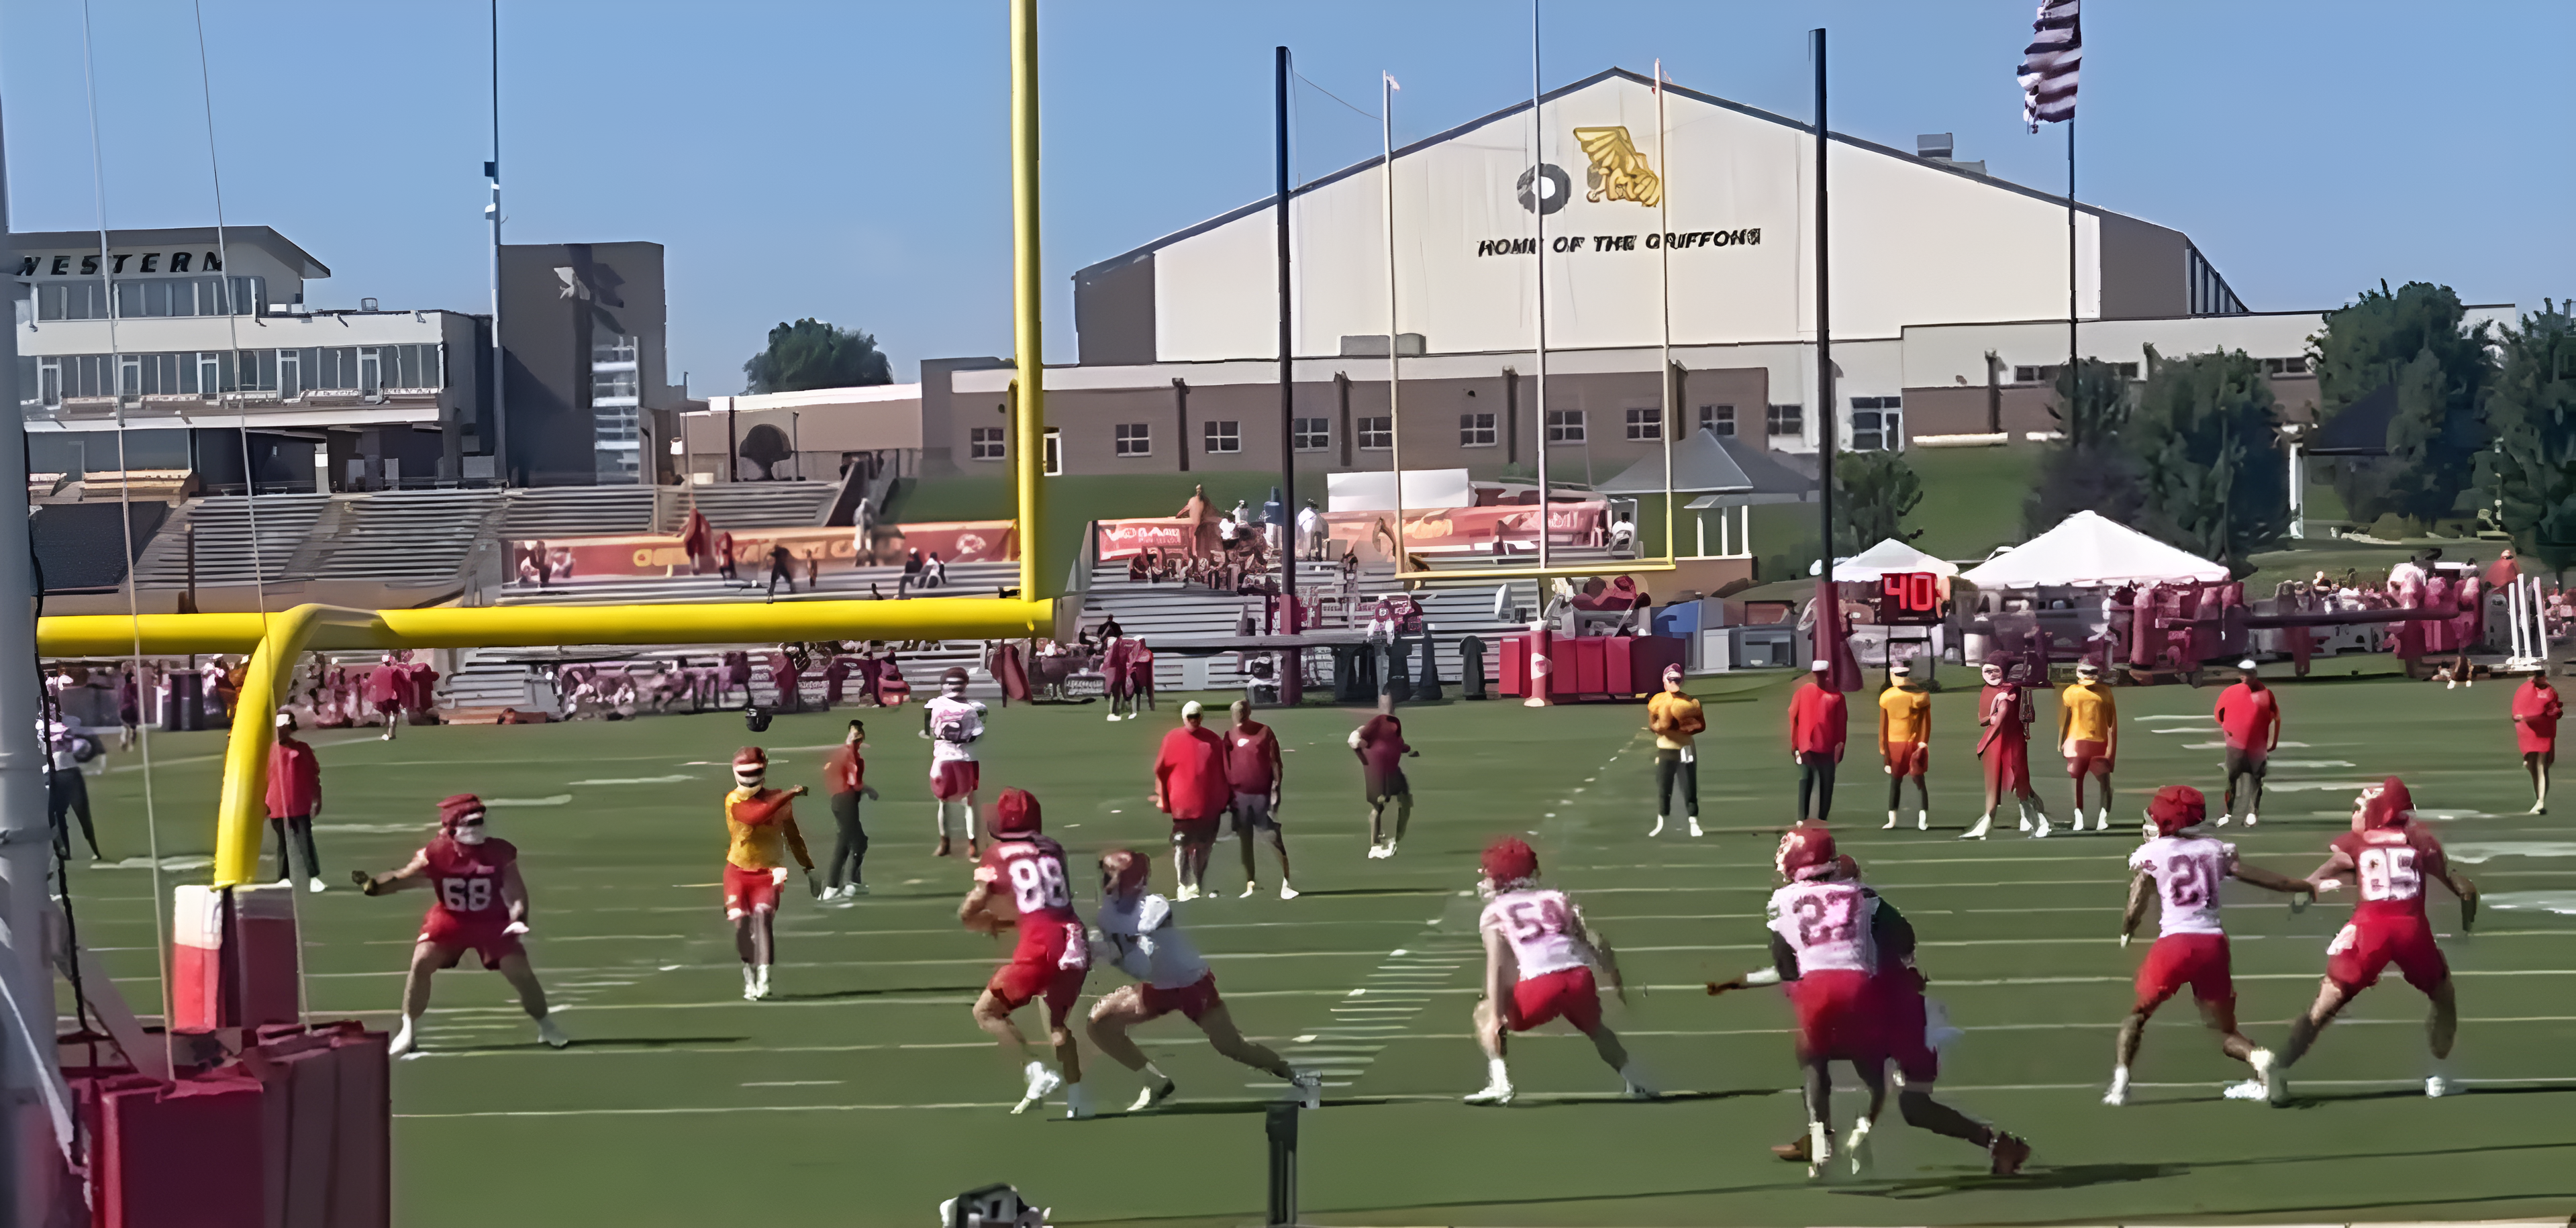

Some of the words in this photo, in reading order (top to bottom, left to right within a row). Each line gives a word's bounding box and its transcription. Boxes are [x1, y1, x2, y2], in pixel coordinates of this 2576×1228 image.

[1553, 236, 1585, 253] OF
[1594, 235, 1637, 252] THE
[1884, 574, 1934, 611] 40
[1008, 856, 1069, 913] 88
[2359, 848, 2420, 901] 85
[442, 878, 491, 912] 68
